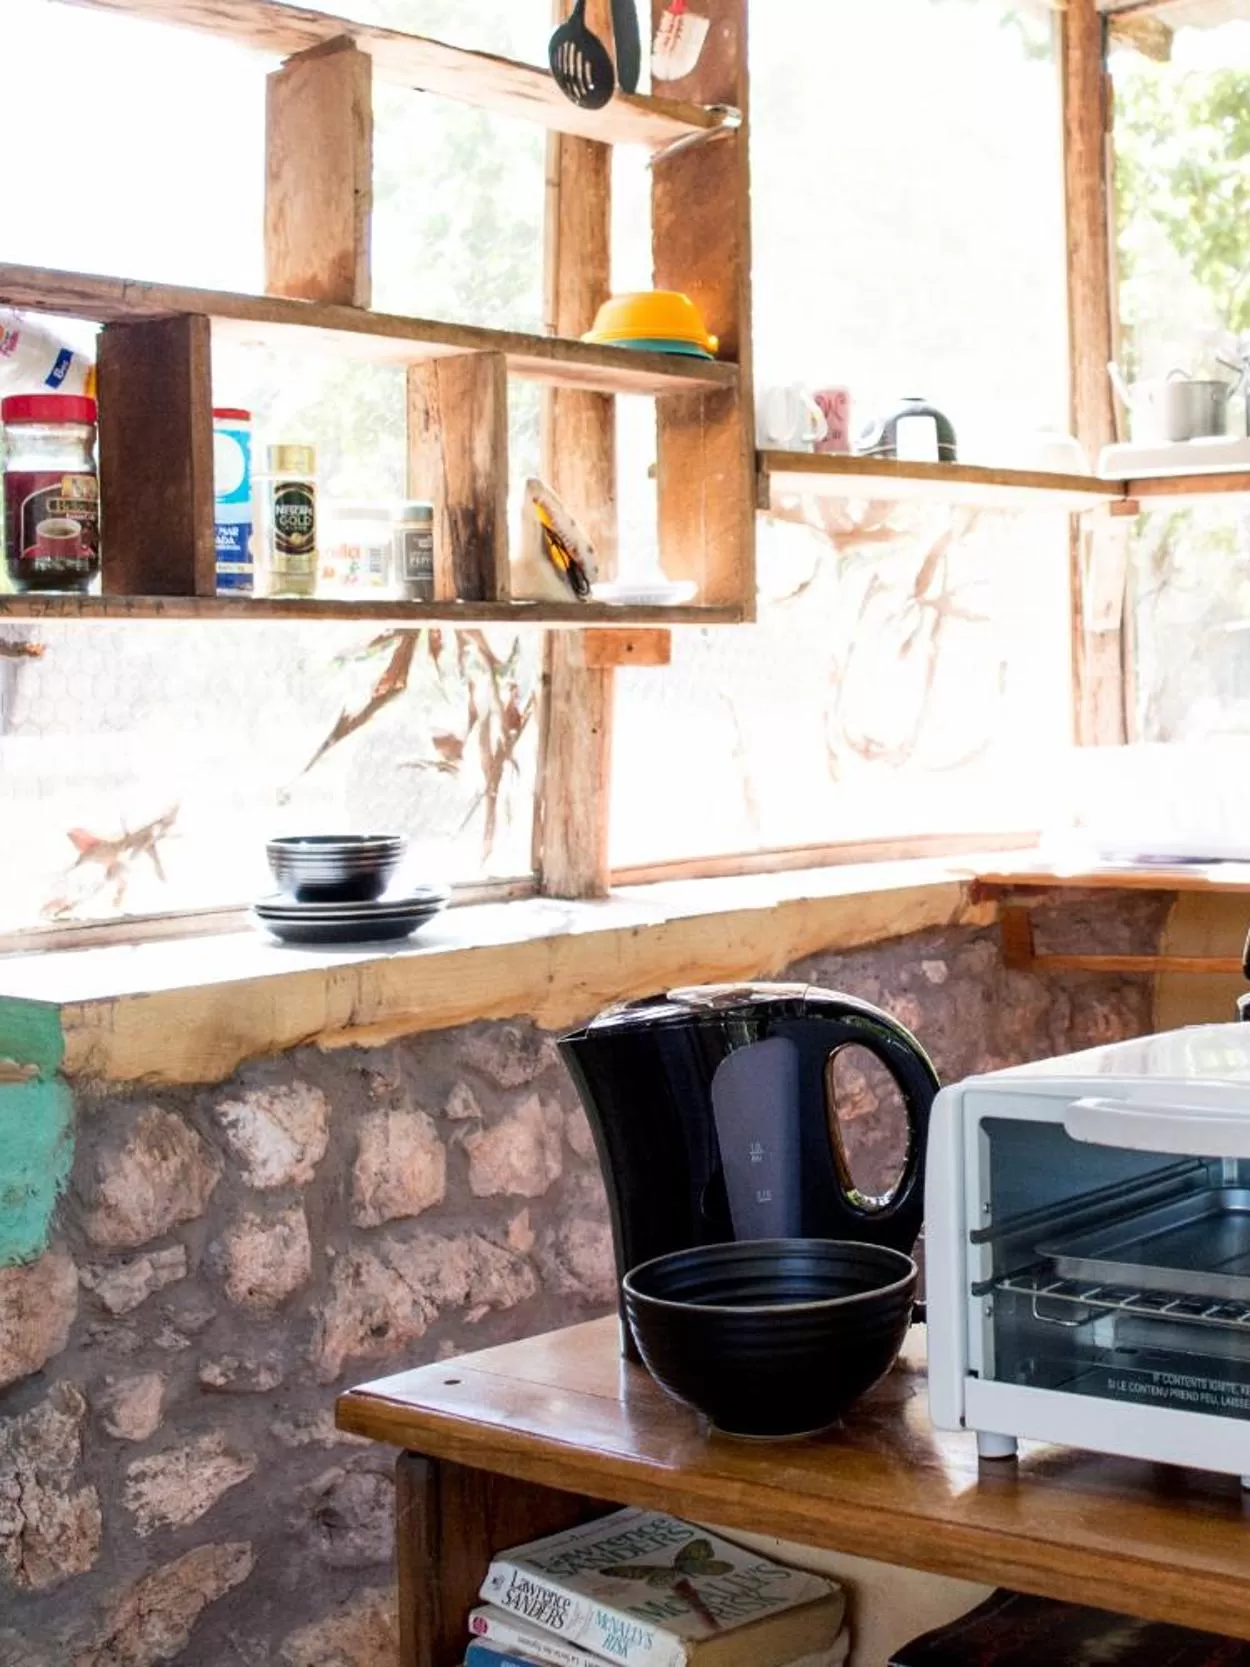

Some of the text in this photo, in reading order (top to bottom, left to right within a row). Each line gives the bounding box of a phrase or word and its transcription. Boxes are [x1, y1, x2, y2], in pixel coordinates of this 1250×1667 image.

[1163, 1373, 1207, 1389] CONTENTS
[525, 1517, 670, 1570] Lawrence
[545, 1524, 695, 1579] SANDERS
[511, 1568, 571, 1609] Lawrence
[501, 1589, 565, 1630] SANDERS
